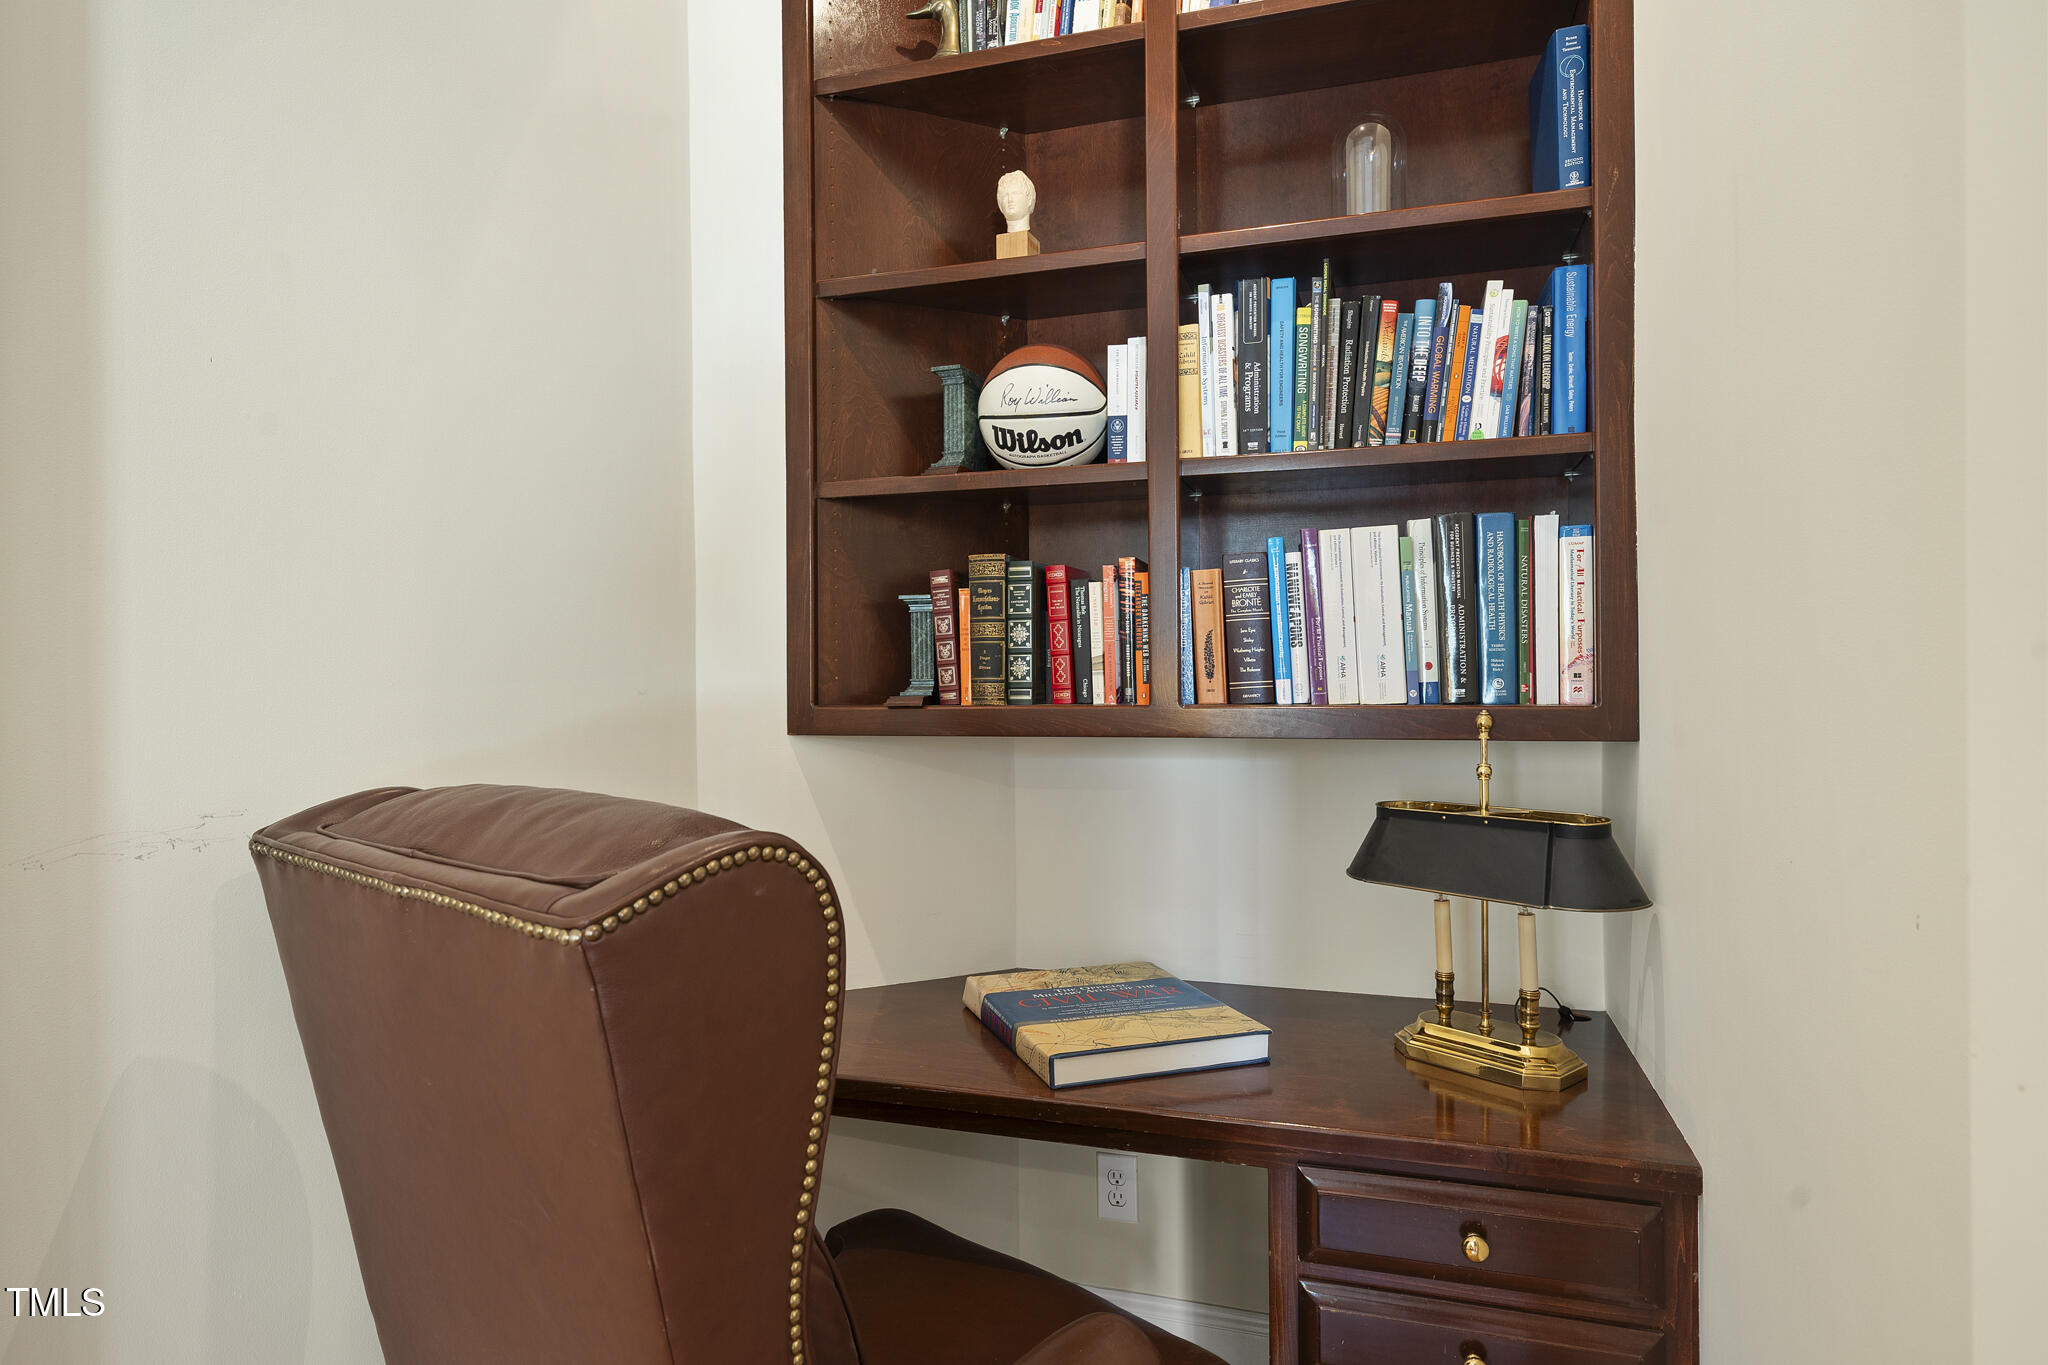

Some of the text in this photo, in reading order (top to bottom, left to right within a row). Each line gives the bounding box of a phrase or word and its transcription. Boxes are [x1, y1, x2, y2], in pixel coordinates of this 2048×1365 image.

[1579, 122, 1583, 130] OF
[1564, 272, 1577, 338] Sustainable Energy
[1217, 312, 1226, 338] GREATEST
[1345, 310, 1354, 329] Shapiro
[1485, 303, 1496, 340] Sustainability
[1217, 339, 1227, 367] DISASTERS
[1380, 320, 1393, 362] Wetlands
[1398, 326, 1407, 354] AMERICAN
[1411, 316, 1433, 382] INTO THE DEEP
[1482, 341, 1493, 367] Principles
[1542, 334, 1552, 354] LINCOLN
[1201, 336, 1209, 376] Information
[1296, 326, 1309, 394] SONGWRITING
[1464, 326, 1479, 394] NATURAL MEDITATION
[1219, 375, 1228, 384] ALL
[1340, 339, 1354, 414] Radiation Protection
[1395, 355, 1404, 389] REVOLUTION
[1427, 335, 1445, 414] GLOBAL WARMING
[1542, 362, 1551, 390] LEADERSHIP
[1000, 382, 1020, 412] Roy
[1219, 385, 1228, 398] TIME
[1243, 371, 1252, 412] Programs
[1252, 361, 1262, 414] Administration
[1478, 379, 1487, 401] Practice
[1411, 395, 1420, 412] BALLARD
[991, 425, 1084, 454] Wilson
[1502, 415, 1510, 436] WILLIAMS
[1036, 450, 1067, 459] BASKETBALL
[1417, 542, 1427, 569] Principles
[1231, 585, 1261, 594] CHARLOTTE
[1419, 575, 1428, 608] Information
[1487, 531, 1496, 630] AND RADIOLOGICAL HEALTH
[1496, 530, 1506, 641] HANDBOOK OF HEALTH PHYSICS
[1141, 596, 1149, 606] THE
[1231, 596, 1262, 608] BRONTË
[1286, 562, 1304, 649] NANOWEAPONS
[1575, 548, 1586, 654] For All Practical Purposes
[1141, 609, 1149, 642] DARKENING
[1405, 603, 1414, 633] Manual
[1421, 609, 1429, 631] Systems
[1316, 635, 1324, 658] Practical
[1458, 604, 1467, 674] ADMINISTRATION
[1316, 657, 1324, 681] Purposes
[1379, 661, 1387, 678] AIHA
[1017, 992, 1107, 1008] CIVIL
[1108, 985, 1185, 1000] WAR
[1032, 990, 1081, 999] MILITARY
[1079, 983, 1127, 991] OFFICIAL
